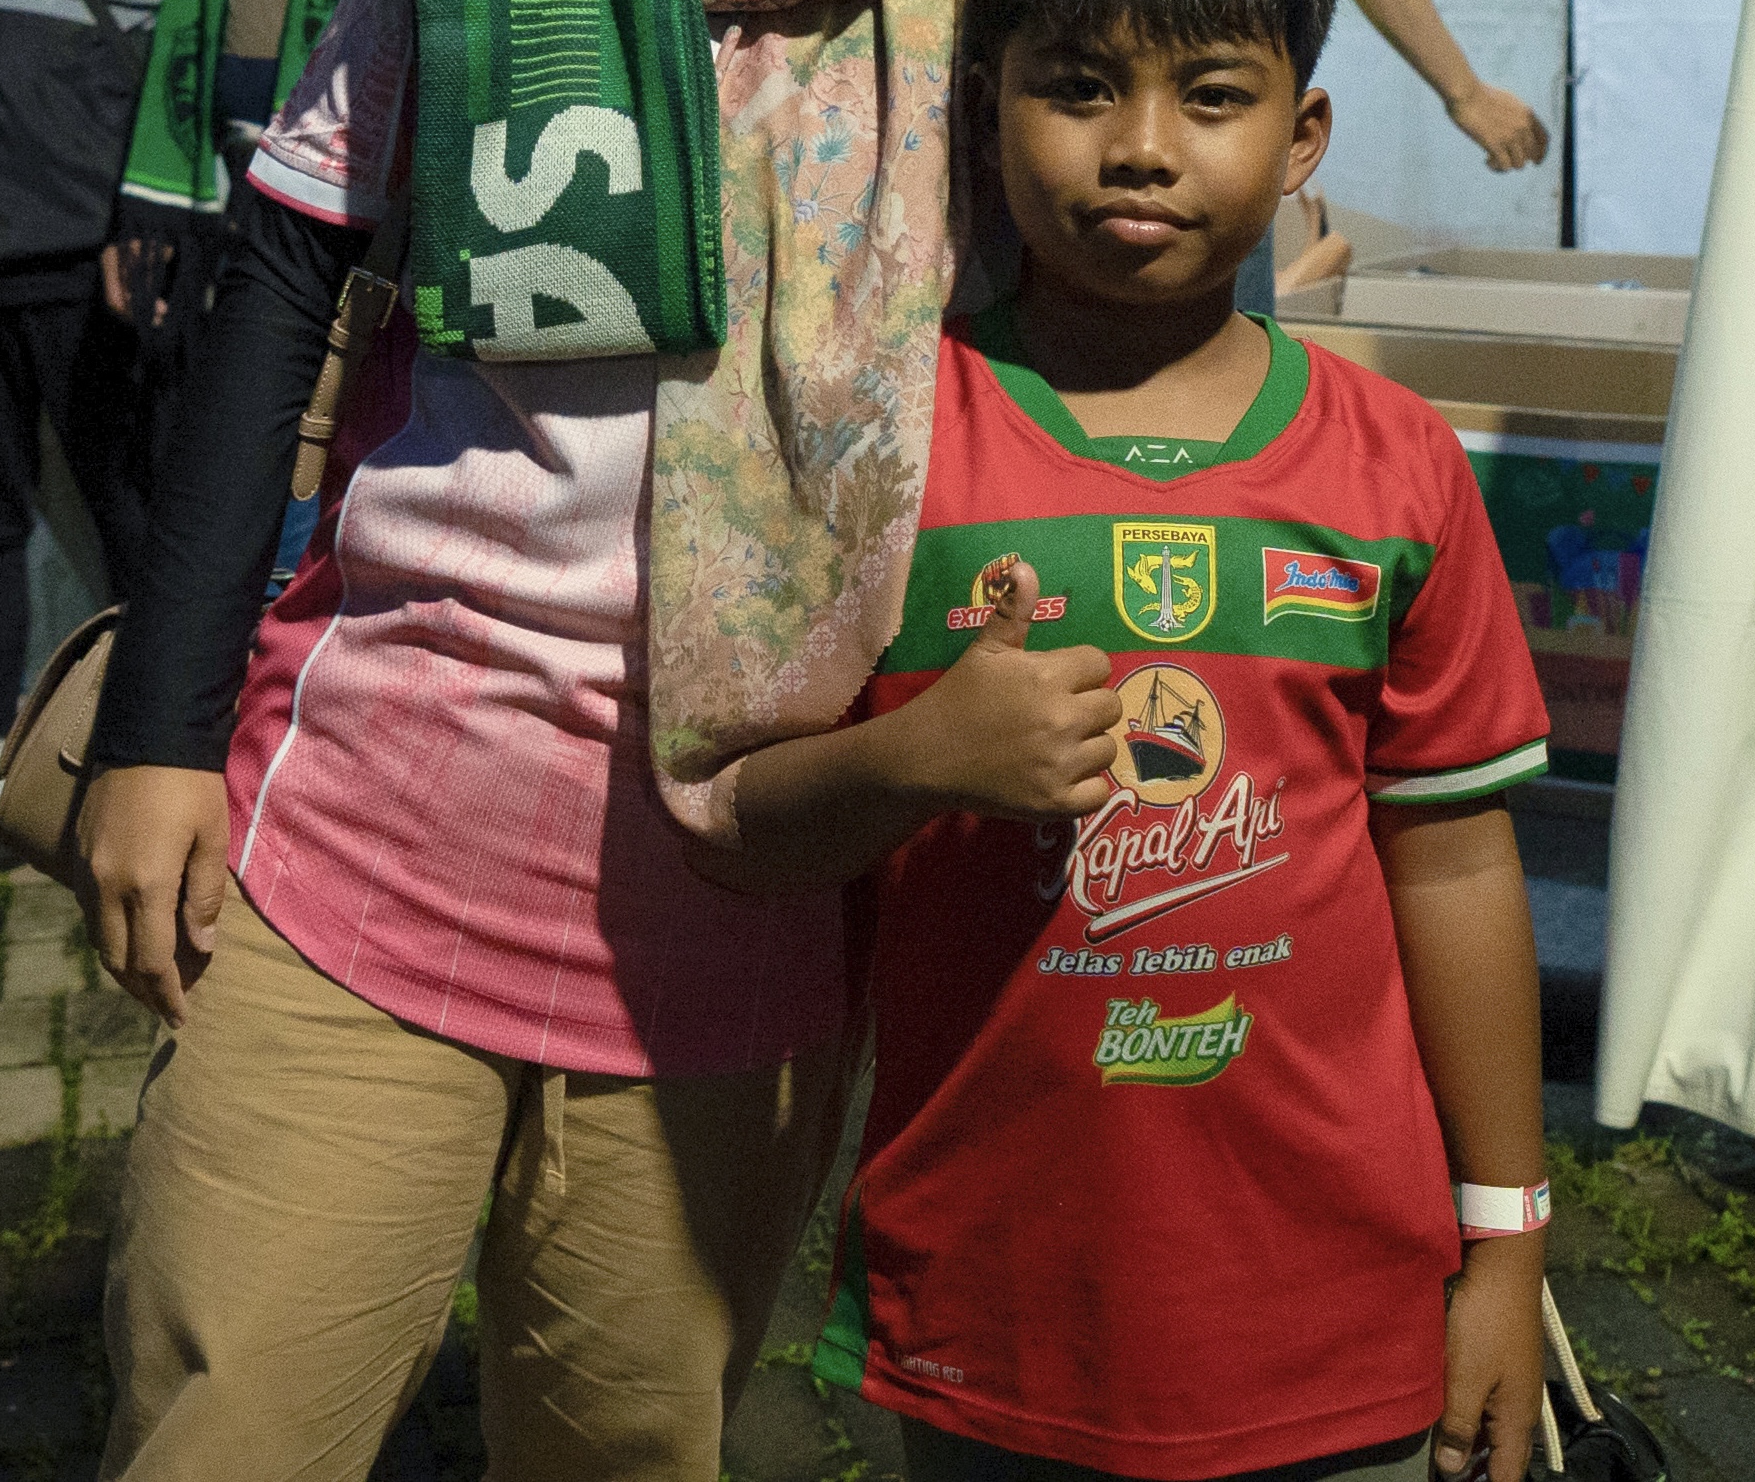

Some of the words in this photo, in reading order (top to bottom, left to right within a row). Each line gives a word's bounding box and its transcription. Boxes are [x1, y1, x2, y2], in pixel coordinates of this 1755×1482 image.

[1122, 528, 1208, 544] PERSEBAYA
[947, 604, 996, 630] EXTR
[1036, 787, 1189, 918] Kapal
[1193, 771, 1286, 871] Api
[1038, 945, 1124, 977] Jelas
[1129, 944, 1218, 976] lebih
[1223, 932, 1294, 969] enak
[1105, 998, 1160, 1027] Teh
[1094, 1013, 1253, 1066] BONTEH
[942, 1365, 964, 1384] RED
